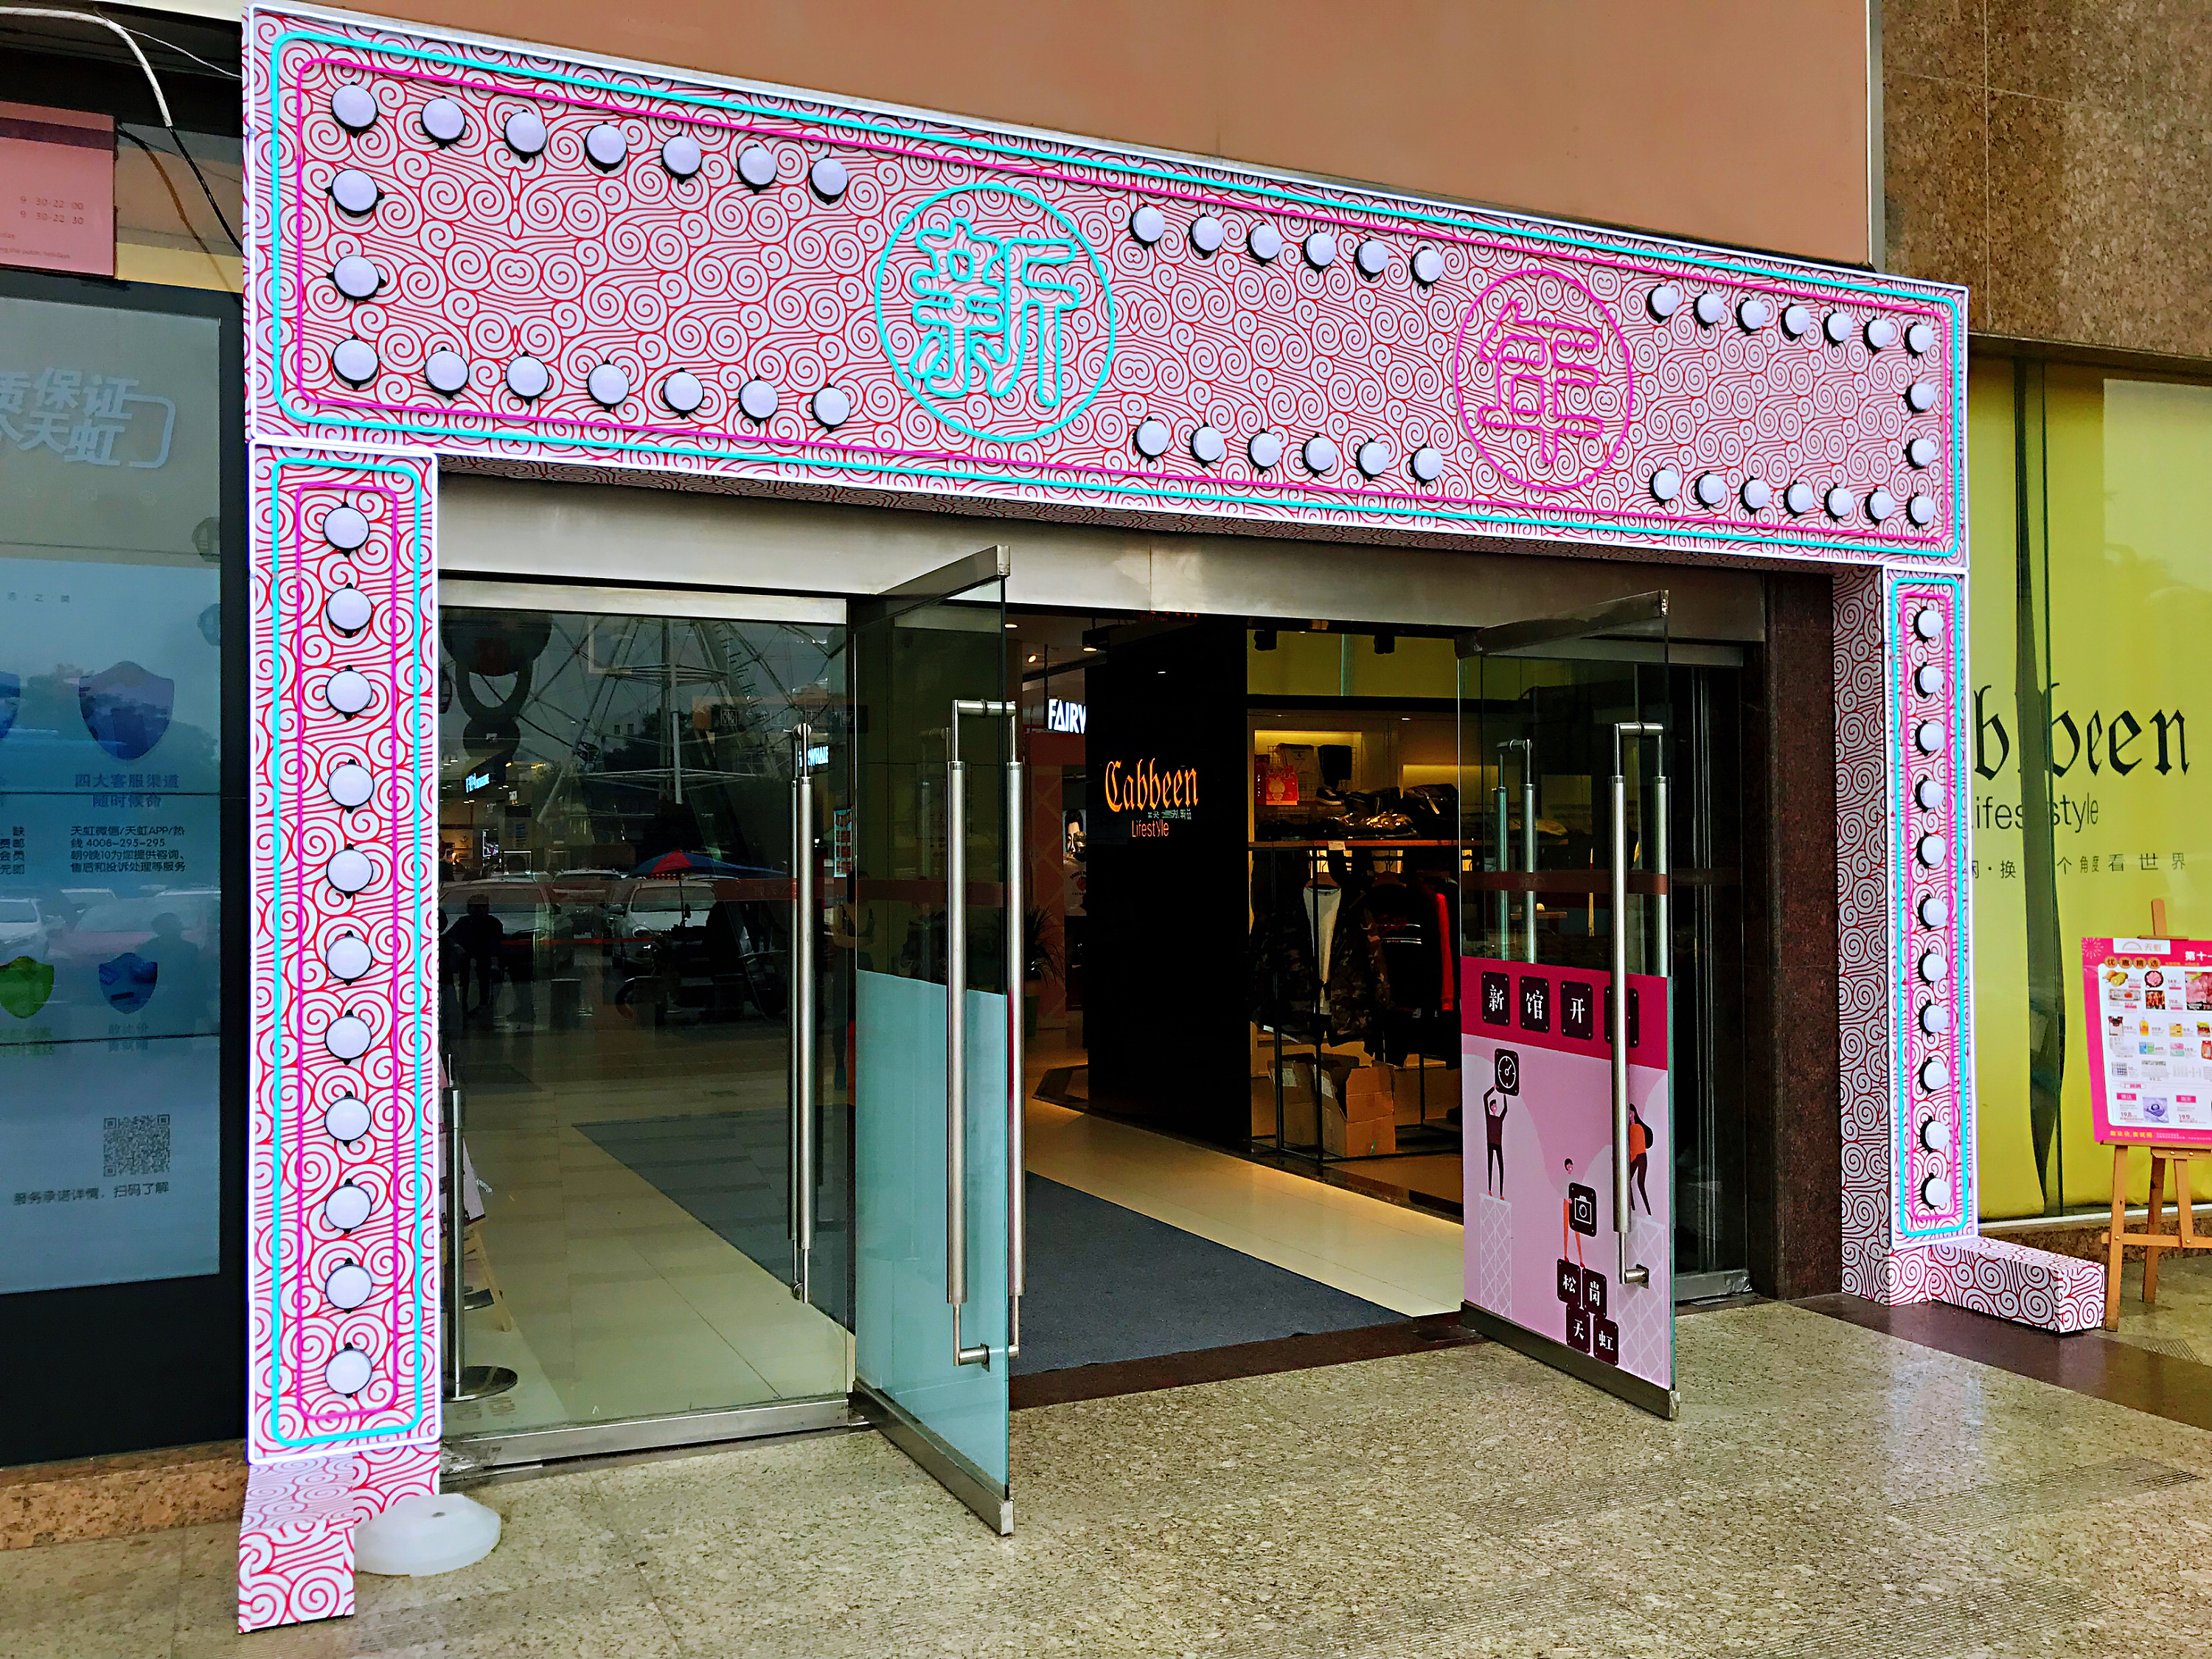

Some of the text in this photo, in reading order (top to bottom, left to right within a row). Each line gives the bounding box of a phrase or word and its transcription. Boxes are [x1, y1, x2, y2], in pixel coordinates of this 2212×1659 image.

[909, 217, 1080, 407] 新
[1105, 758, 1199, 812] Cabbeen
[1131, 818, 1169, 838] Lifestyle
[1971, 792, 2099, 833] ifestyle
[1562, 1273, 1600, 1307] 松岗
[1573, 1318, 1614, 1352] 天虹
